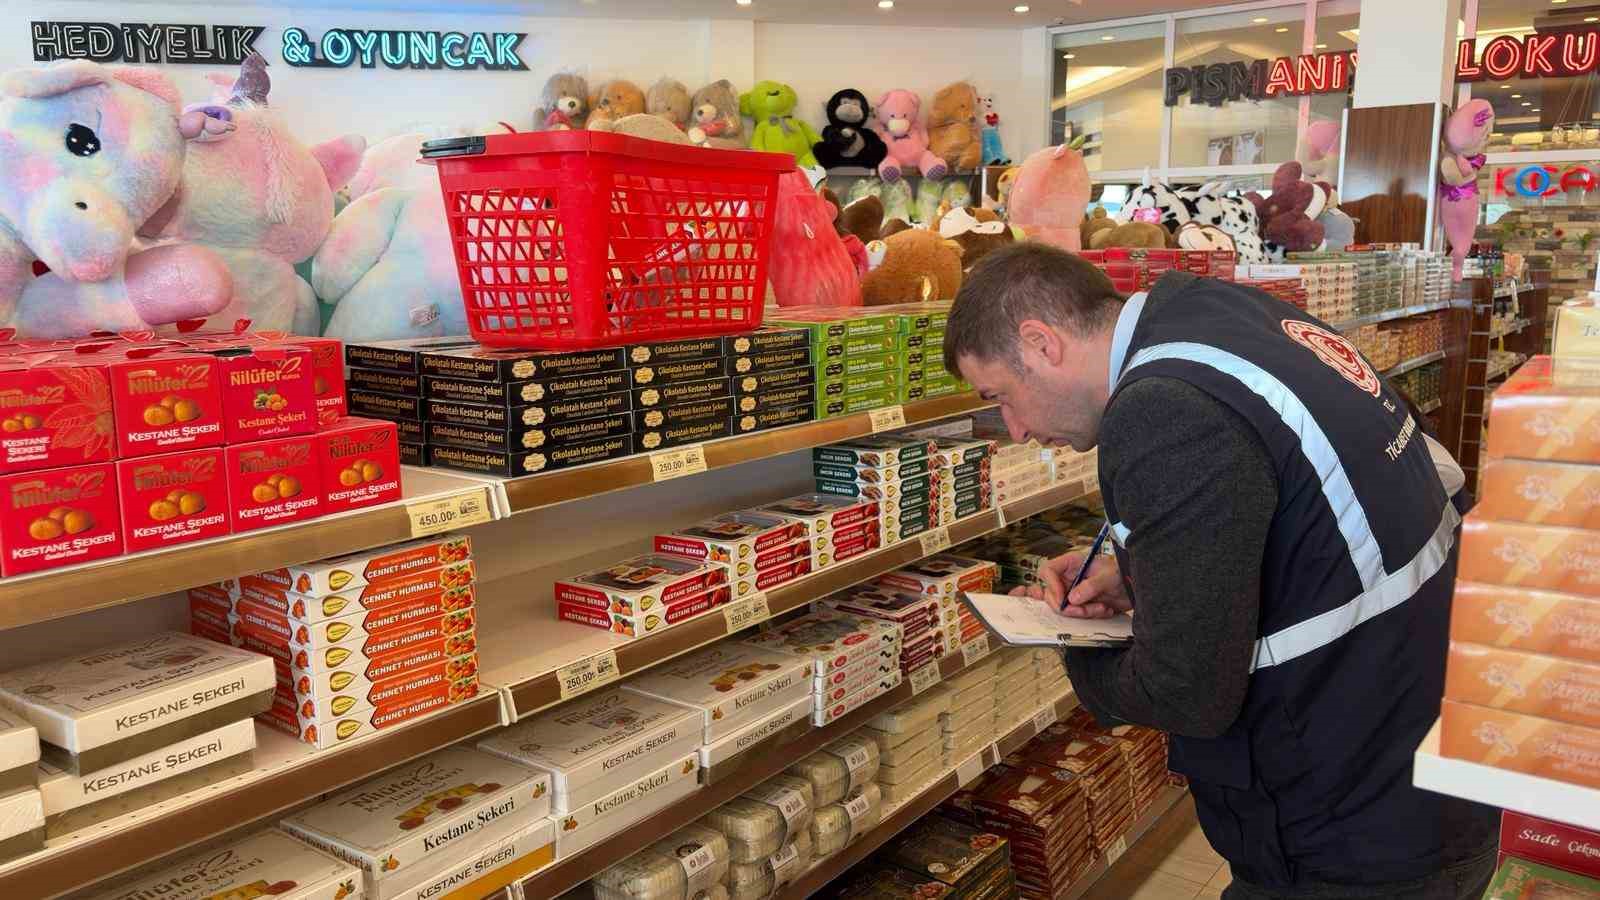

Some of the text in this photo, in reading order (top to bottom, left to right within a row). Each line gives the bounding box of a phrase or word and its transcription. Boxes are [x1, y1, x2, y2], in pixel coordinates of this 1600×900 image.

[281, 27, 522, 66] & OYUNCAK
[451, 360, 473, 370] Kestane
[474, 362, 493, 372] Şekeri
[572, 355, 595, 366] Kestane
[597, 354, 614, 363] Şekeri
[231, 367, 282, 386] Nilüfer
[580, 378, 603, 389] Kestane
[604, 376, 621, 386] Şekeri
[459, 383, 483, 394] Kestane
[484, 385, 502, 396] Şekeri
[460, 407, 483, 418] Kestane
[485, 409, 503, 420] Şekeri
[580, 400, 603, 412] Kestane
[604, 398, 621, 408] Şekeri
[238, 411, 306, 429] Kestane Şekeri
[581, 422, 603, 434] Kestane
[605, 419, 622, 430] Şekeri
[2, 436, 50, 448] KESTANE
[128, 429, 180, 443] KESTANE
[181, 421, 220, 437] ŞEKERİ
[460, 429, 483, 440] Kestane
[484, 431, 503, 443] Şekeri
[462, 451, 486, 463] Kestane
[486, 453, 505, 466] Şekeri
[581, 444, 604, 456] Kestane
[605, 441, 622, 451] Şekeri
[328, 487, 368, 502] KESTANE
[368, 480, 398, 495] ŞEKERİ
[239, 504, 284, 520] KESTANE
[285, 496, 318, 511] ŞEKERİ
[133, 521, 186, 539] KESTANE
[187, 512, 225, 529] ŞEKERİ
[12, 542, 71, 560] KESTANE
[73, 532, 115, 550] ŞEKERİ
[367, 557, 435, 578] CENNET HURMASI
[364, 581, 436, 604] CENNET HURMASI
[561, 592, 586, 603] KESTANE
[663, 590, 685, 602] KESTANE
[367, 605, 437, 629] CENNET HURMASI
[564, 612, 588, 622] KESTANE
[668, 608, 691, 620] KESTANE
[367, 630, 437, 654] CENNET HURMASI
[369, 651, 440, 677] CENNET HURMASI
[372, 675, 441, 700] CENNET HURMASI
[735, 676, 792, 710] Kestane Şekeri
[116, 677, 245, 731] KESTANE ŞEKERİ
[375, 696, 445, 724] CENNET HURMASI
[736, 711, 793, 750] KESTANE ŞEKERİ
[602, 727, 677, 771] KESTANE ŞEKERİ
[83, 739, 222, 795] KESTANE ŞEKERİ
[594, 772, 669, 815] Kestane Şekeri
[424, 797, 515, 852] Kestane Şekeri
[1519, 828, 1560, 846] Sade
[417, 844, 516, 900] KESTANE ŞEKERİ
